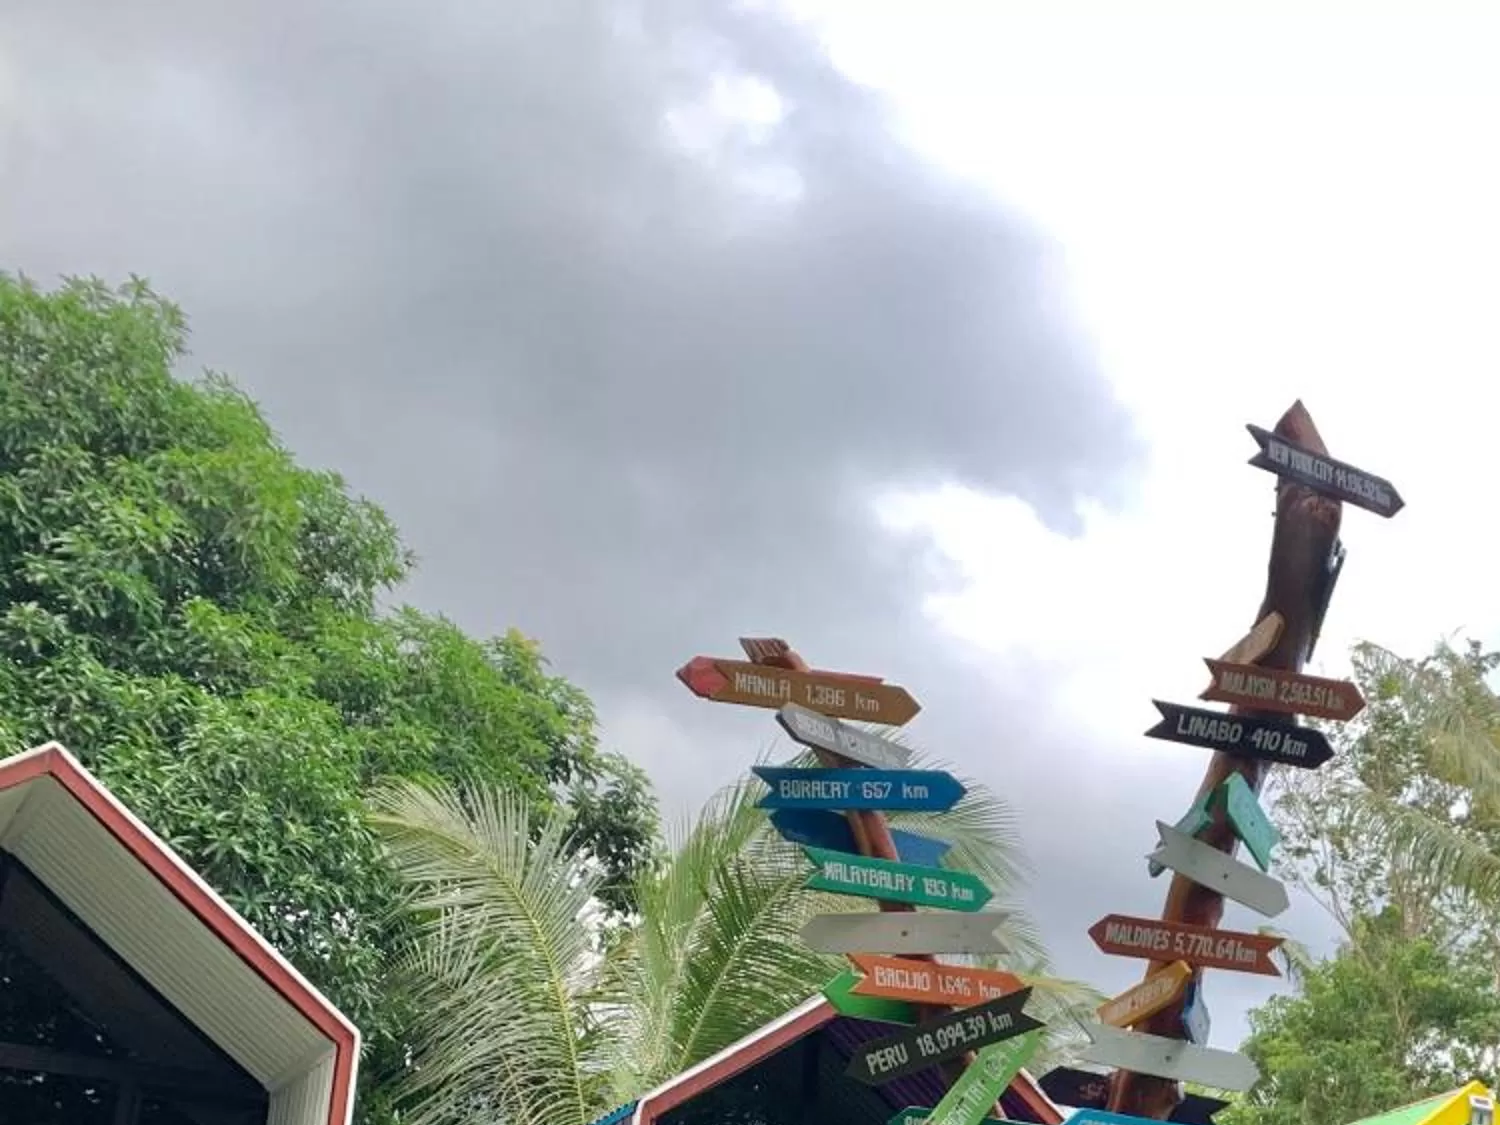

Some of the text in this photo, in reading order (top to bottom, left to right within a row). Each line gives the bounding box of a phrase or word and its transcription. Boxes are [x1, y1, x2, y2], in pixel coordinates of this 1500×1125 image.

[735, 671, 791, 700] MANILA
[855, 693, 880, 713] km
[1177, 713, 1308, 758] LINABO 410 km
[779, 779, 852, 800] BORACAY
[902, 781, 929, 799] km
[823, 860, 915, 892] MALAYBALAY
[951, 881, 974, 901] km
[1105, 921, 1171, 950] MALDIVES
[1235, 940, 1258, 963] km
[873, 966, 931, 992] BAGUIO
[978, 980, 1002, 999] km
[864, 1042, 910, 1076] PERU
[987, 1010, 1014, 1034] km
